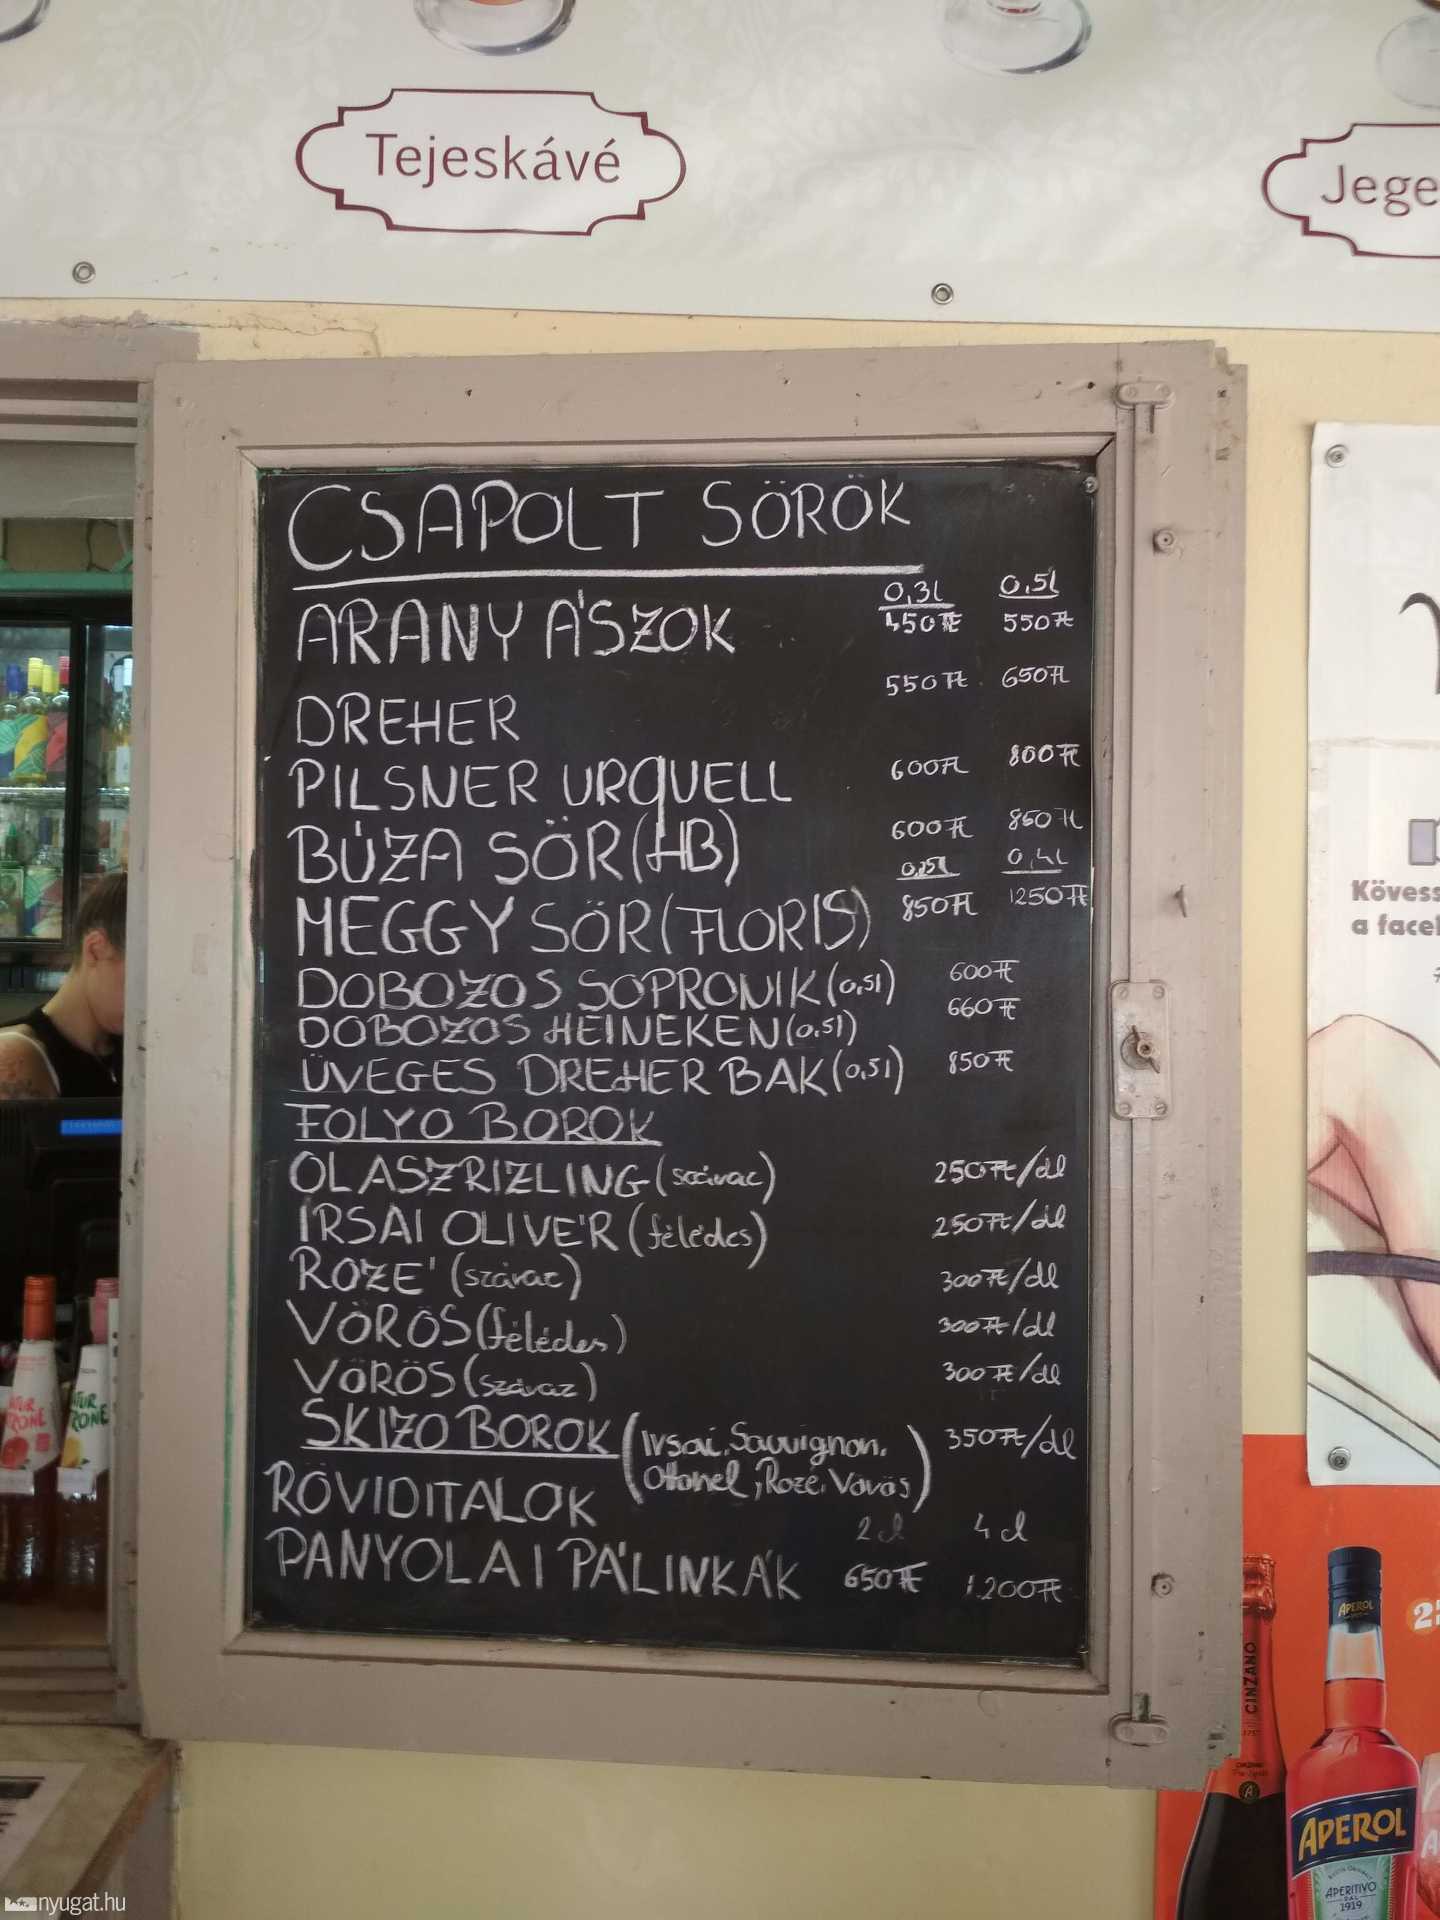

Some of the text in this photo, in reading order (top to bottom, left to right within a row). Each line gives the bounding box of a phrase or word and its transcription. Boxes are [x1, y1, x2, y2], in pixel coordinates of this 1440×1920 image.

[365, 133, 622, 189] Tejeskávé
[1320, 164, 1439, 217] Jege
[288, 473, 911, 571] CSAPOLT SÖRÖK
[297, 598, 524, 665] ARANY
[297, 692, 521, 747] DREHER
[288, 758, 539, 812] PILSNER
[296, 894, 515, 957] MEGGY
[1352, 918, 1369, 936] a
[298, 967, 563, 1011] DOBOZOS
[299, 1013, 531, 1049] DOBOZOS
[302, 1052, 497, 1095] ÜVEGES
[516, 1053, 713, 1096] DREHER
[284, 1101, 655, 1143] FOLYO BOROK
[300, 1200, 424, 1246] IRSAI
[301, 1397, 612, 1455] SKIZO BOROK
[263, 1460, 598, 1528] RÖVIDITALOK
[265, 1526, 544, 1591] PANYOLAI
[1297, 1807, 1408, 1862] APEROL
[1325, 1881, 1377, 1899] APERITIVO
[1340, 1900, 1363, 1912] 1919
